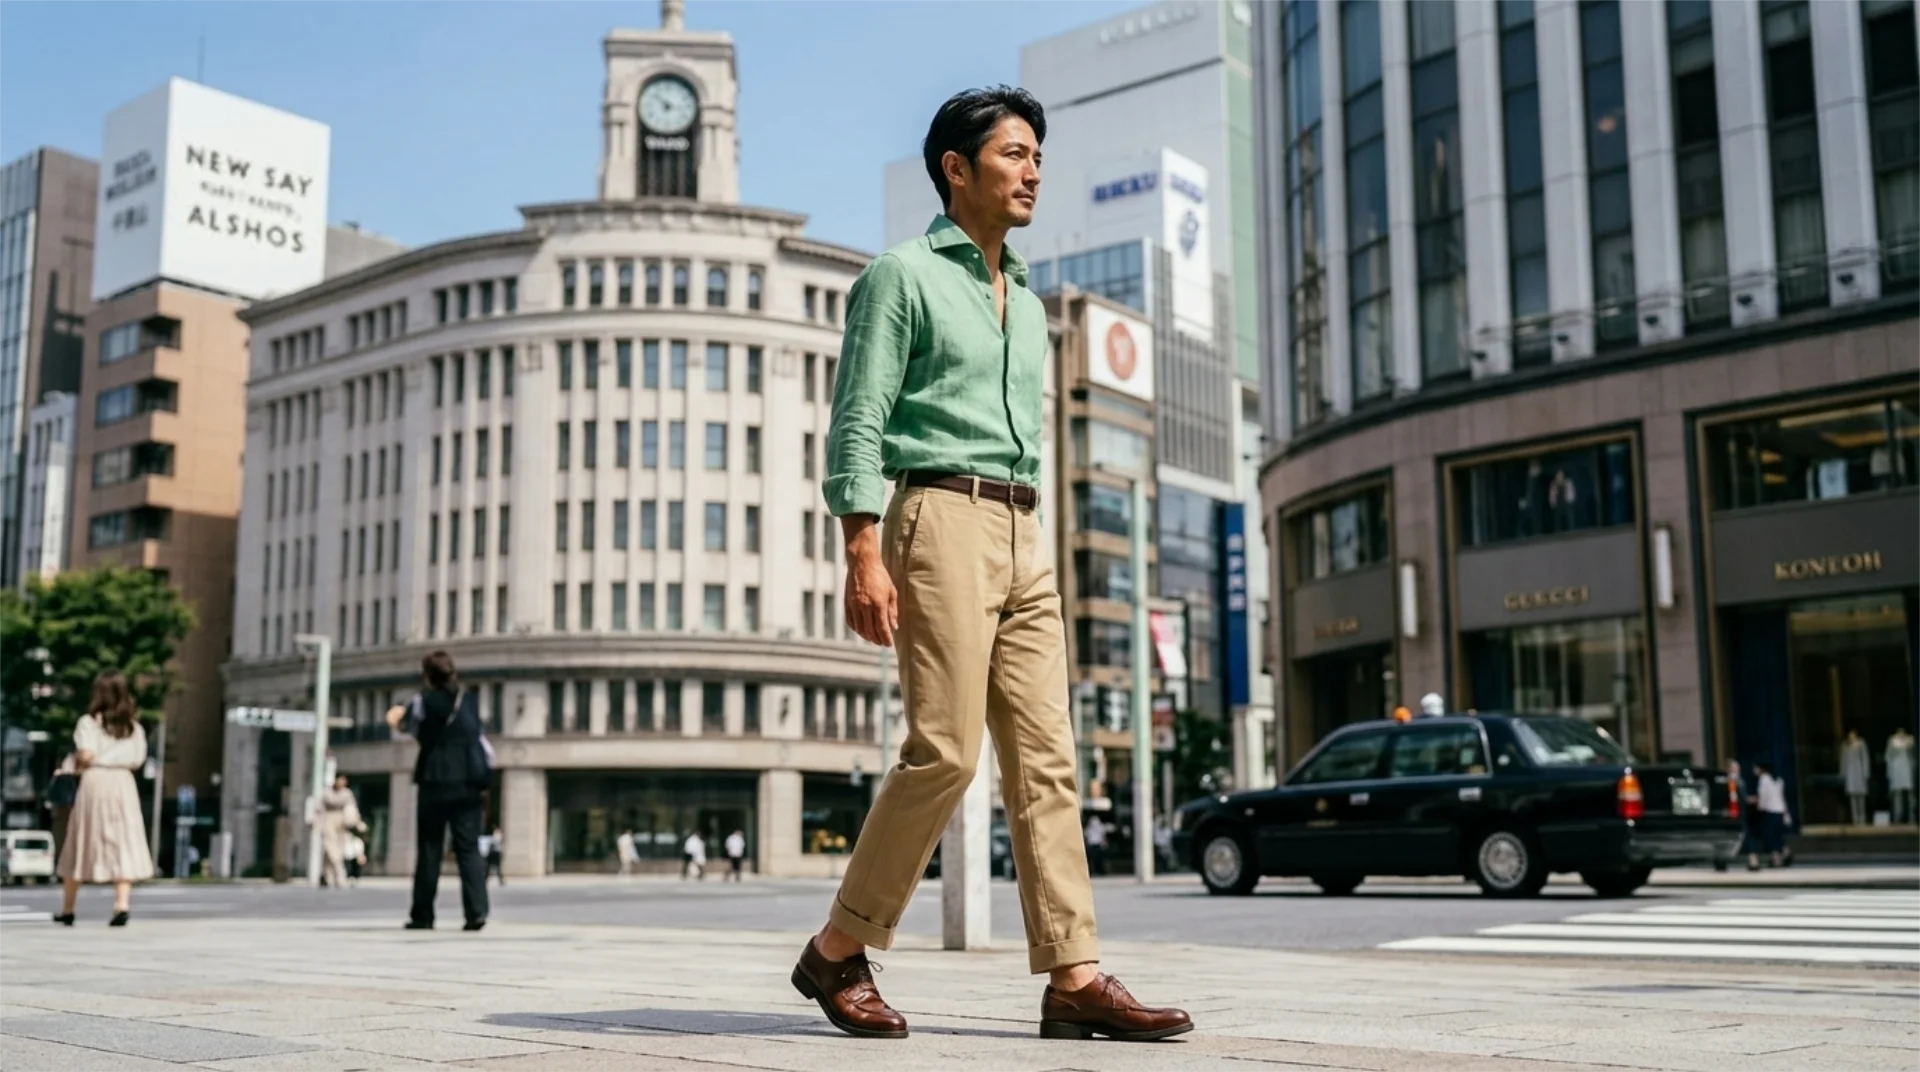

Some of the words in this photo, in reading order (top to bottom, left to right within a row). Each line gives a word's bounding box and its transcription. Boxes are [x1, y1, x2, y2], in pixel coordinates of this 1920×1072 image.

[186, 145, 250, 179] NEW
[264, 167, 313, 196] SAY
[187, 205, 305, 253] ALSHOS
